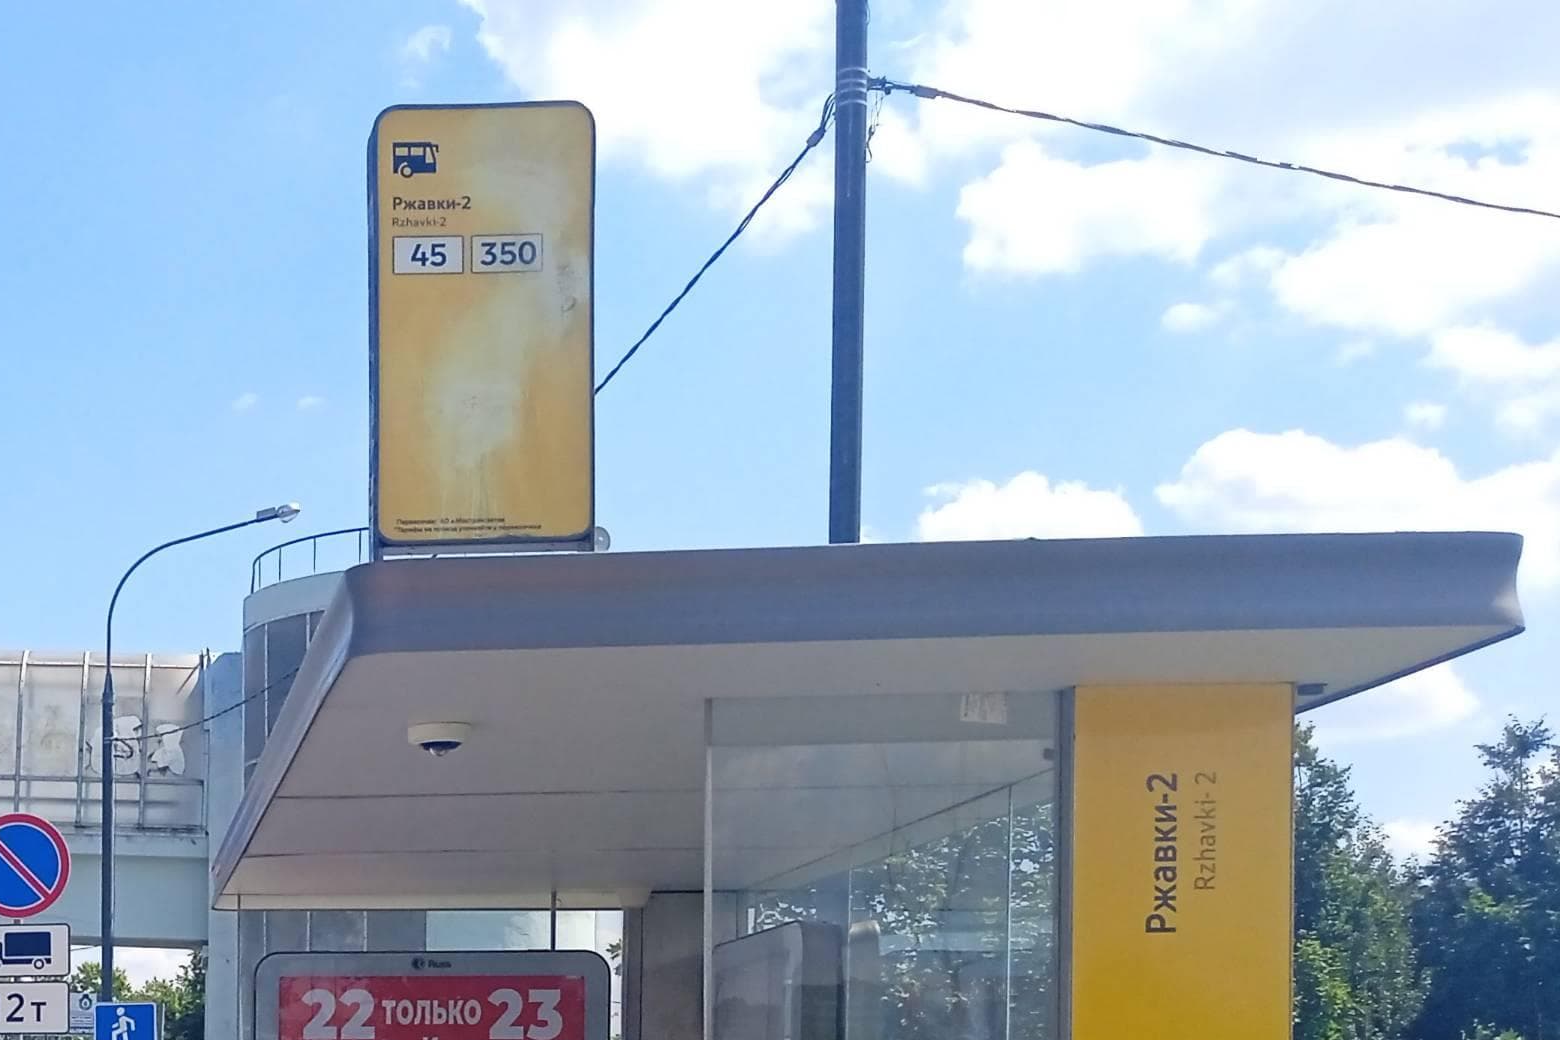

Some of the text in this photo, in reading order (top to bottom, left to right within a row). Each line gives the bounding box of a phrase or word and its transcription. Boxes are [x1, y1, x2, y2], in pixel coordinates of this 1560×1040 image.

[392, 195, 472, 211] Ржавки-2
[392, 216, 447, 228] Rzhavki-2
[410, 243, 447, 267] 45
[480, 240, 537, 266] 350
[1145, 772, 1178, 934] Ржавки-2
[301, 988, 563, 1040] 22 ТОЛЬКО 23
